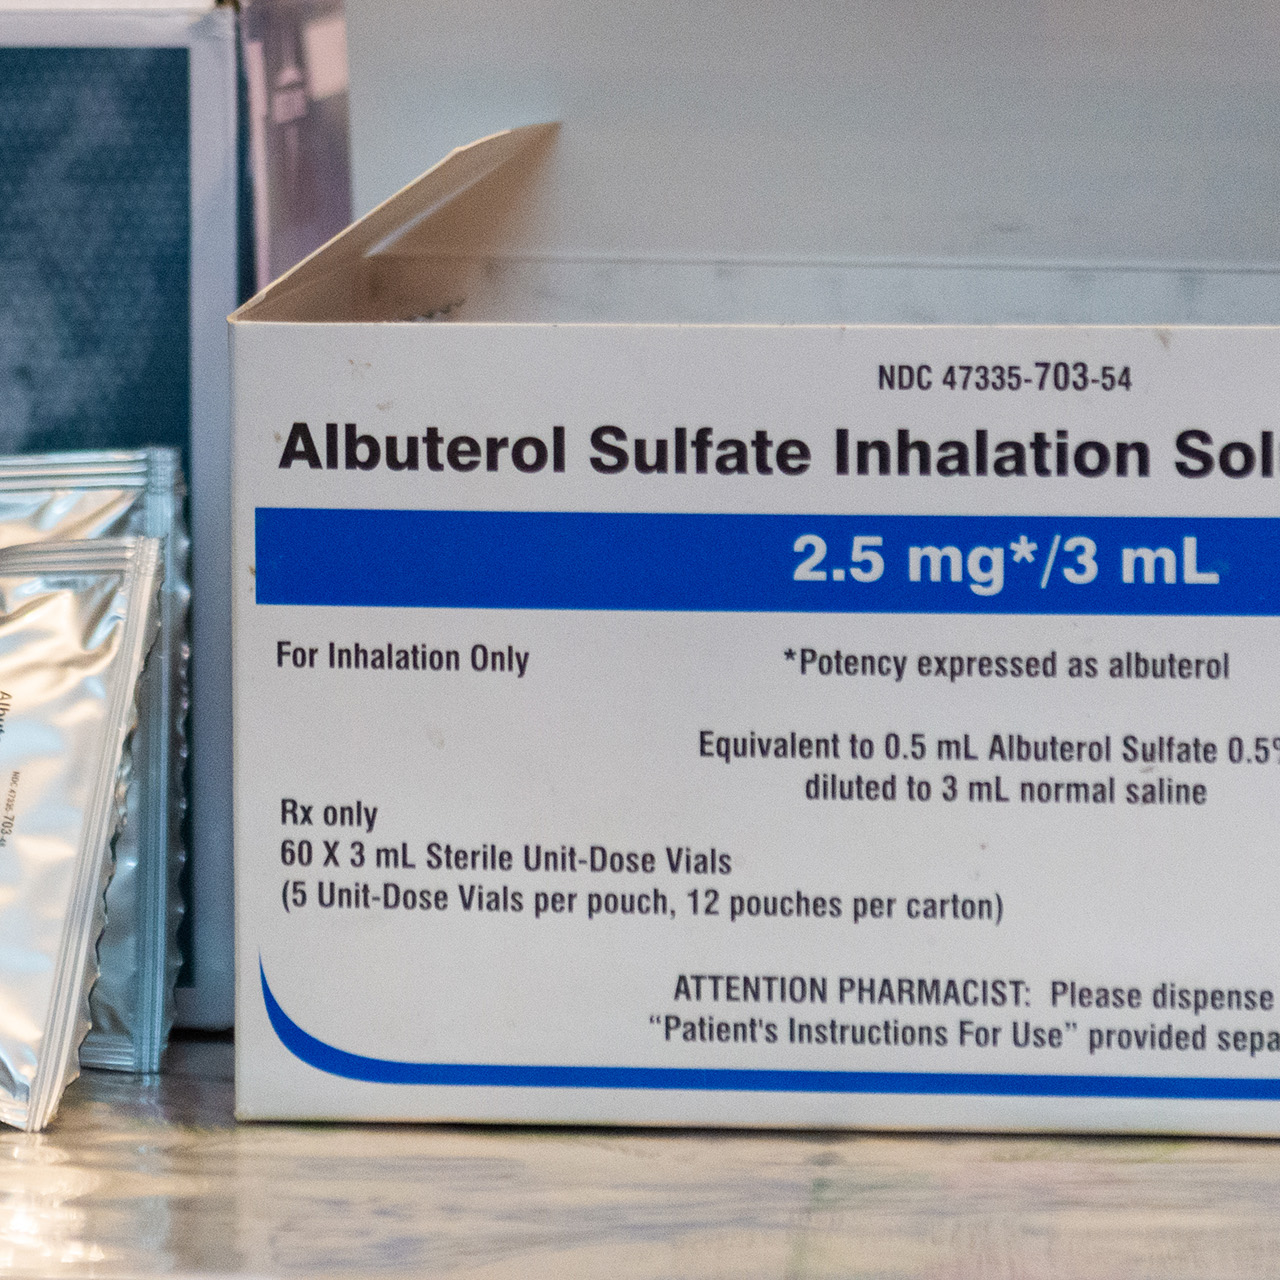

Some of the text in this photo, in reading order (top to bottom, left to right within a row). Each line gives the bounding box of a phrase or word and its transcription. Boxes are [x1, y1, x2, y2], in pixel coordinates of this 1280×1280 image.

[878, 361, 1132, 391] NDC 47335-703-54
[279, 422, 565, 473] Albuterol
[589, 425, 811, 476] Sulfate
[836, 428, 1150, 478] Inhalation
[793, 535, 885, 582] 2.5
[1122, 537, 1220, 584] mL
[277, 640, 529, 678] For Inhalation Only
[917, 650, 1057, 683] expressed
[1067, 656, 1098, 678] as
[1109, 651, 1229, 680] albuterol
[699, 730, 840, 764] Equivalent
[849, 733, 874, 759] to
[884, 732, 926, 760] 0.5
[937, 733, 978, 761] mL
[988, 733, 1111, 762] Albuterol
[1122, 734, 1217, 764] Sulfate
[805, 773, 1207, 805] diluted to 3 mL normal saline
[281, 798, 378, 833] Rx only
[281, 839, 732, 875] 60 X 3 mL Sterile Unit-Dose Vials
[282, 880, 1003, 925] (5 Unit-Dose Vials per pouch, 12 pouches per carton)
[674, 974, 827, 1003] ATTENTION
[839, 977, 1030, 1007] PHARMACIST:
[1051, 980, 1142, 1009] Please
[1152, 982, 1274, 1015] dispense
[789, 1017, 947, 1046] Instructions
[959, 1019, 1001, 1047] For
[1089, 1023, 1206, 1055] provided
